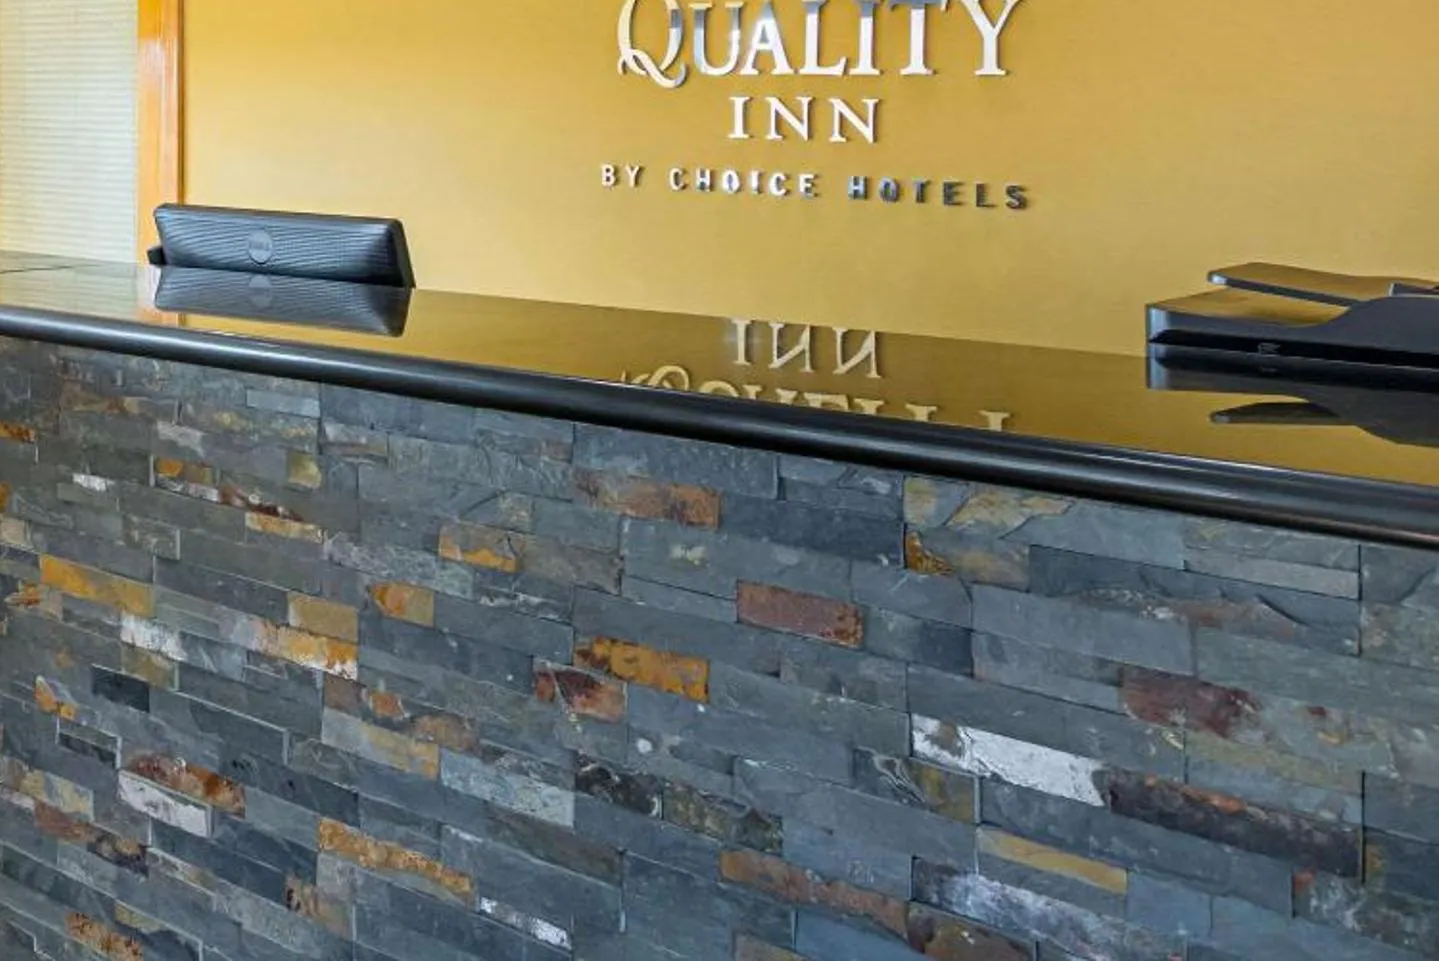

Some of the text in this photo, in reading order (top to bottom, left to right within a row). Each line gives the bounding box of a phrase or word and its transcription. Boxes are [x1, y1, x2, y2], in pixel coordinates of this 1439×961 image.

[726, 96, 882, 144] INN
[600, 163, 1029, 211] BY CHOICE HOTELS
